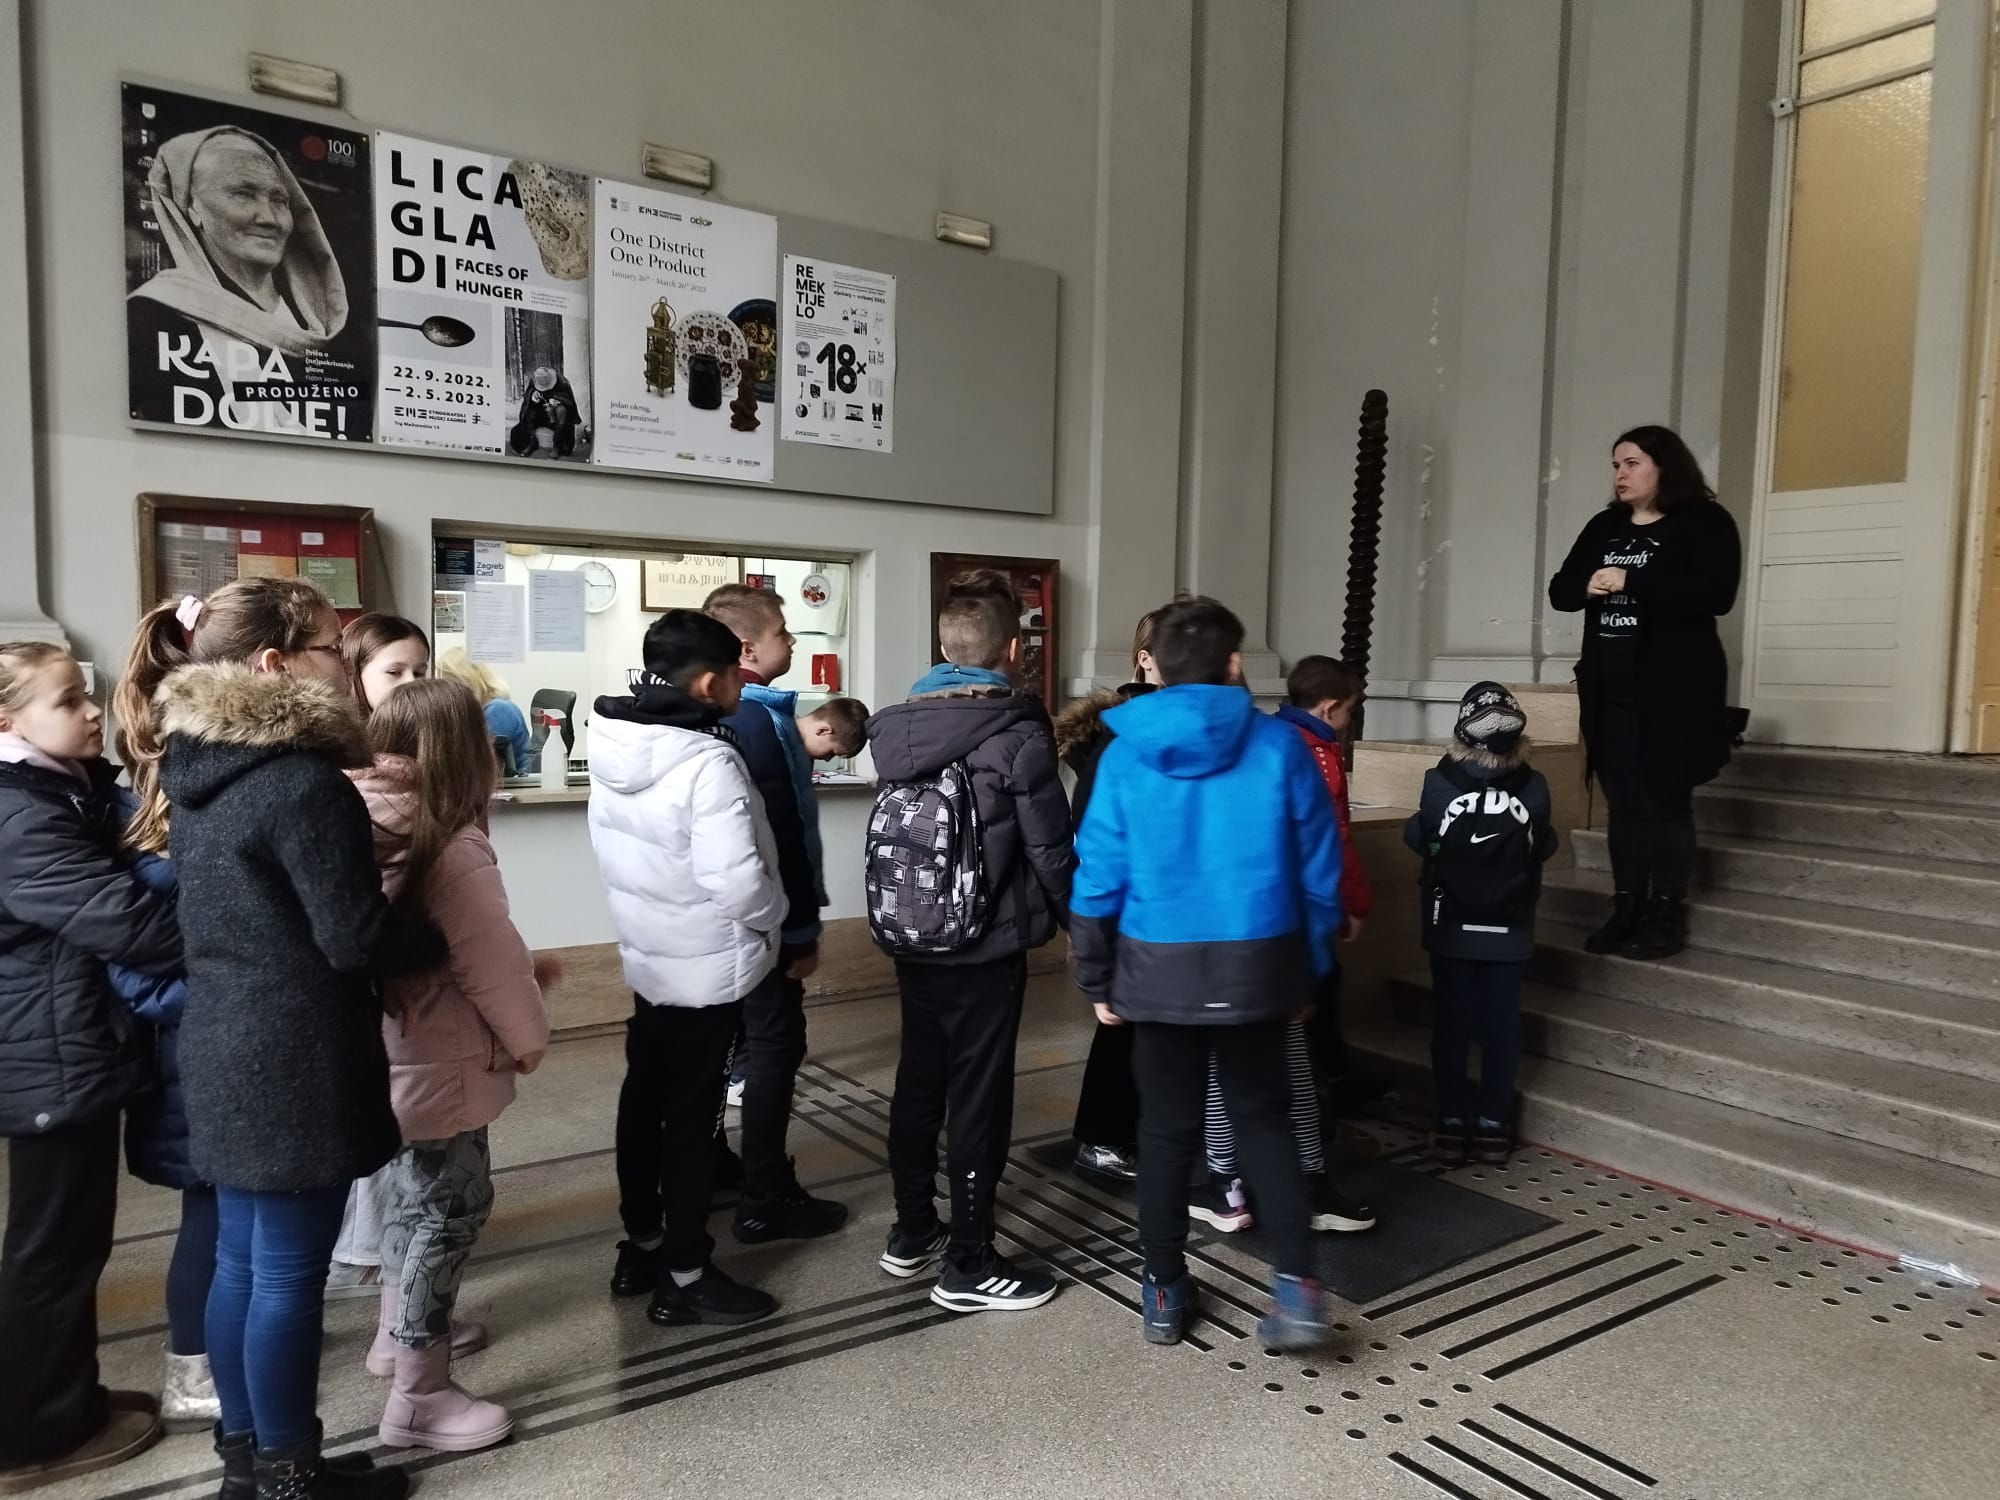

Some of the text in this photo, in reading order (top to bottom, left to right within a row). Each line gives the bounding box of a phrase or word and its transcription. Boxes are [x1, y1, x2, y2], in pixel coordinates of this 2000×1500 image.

[328, 139, 352, 157] 100
[391, 150, 523, 209] LICA
[391, 201, 496, 250] GLA
[610, 227, 705, 259] One District
[392, 247, 446, 289] DI
[456, 258, 529, 281] FACES OF
[610, 246, 706, 278] One Product
[796, 264, 814, 278] RE
[456, 279, 524, 301] HUNGER
[796, 278, 825, 295] MEK
[796, 291, 825, 308] TIJE
[796, 304, 815, 319] LO
[158, 331, 294, 383] KAPA
[245, 384, 359, 398] PRODUŽENO
[476, 562, 504, 570] Zagreb
